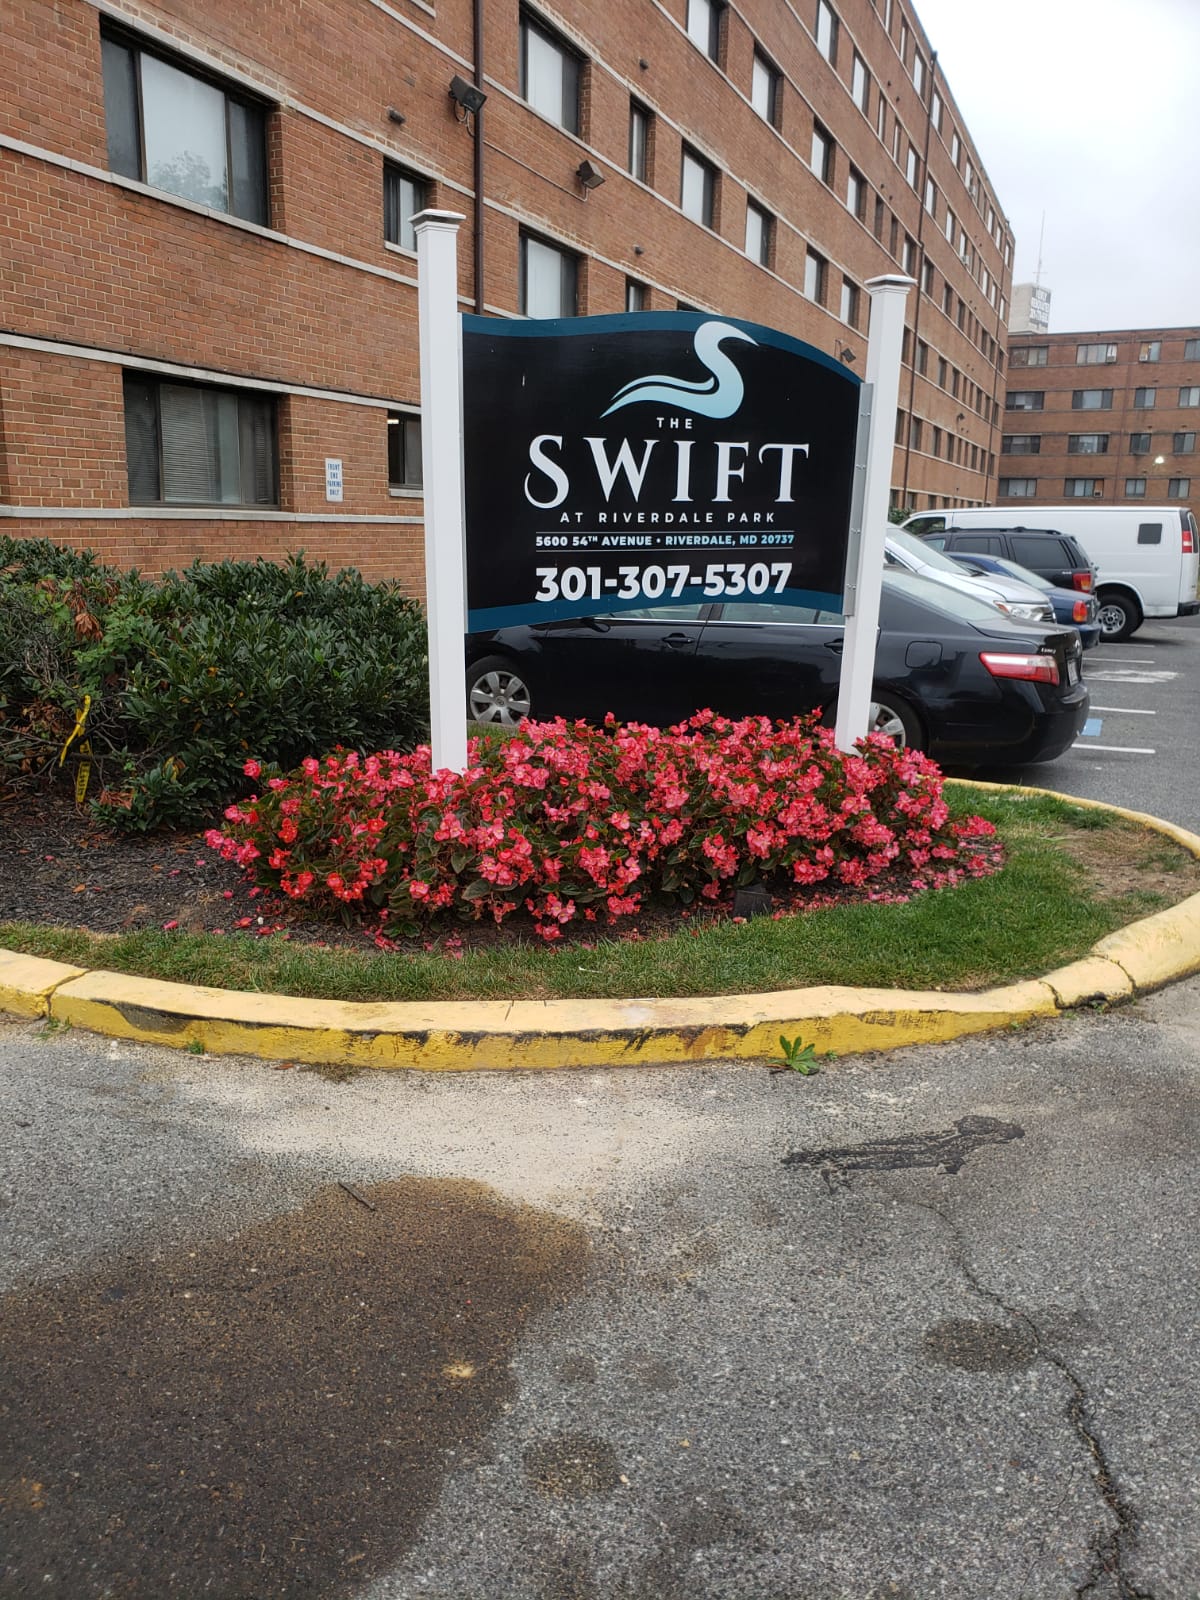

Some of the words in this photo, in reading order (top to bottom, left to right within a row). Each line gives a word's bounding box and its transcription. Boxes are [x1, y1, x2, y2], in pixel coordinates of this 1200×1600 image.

[656, 417, 693, 429] THE
[524, 434, 810, 509] SWIFT
[560, 512, 584, 523] AT
[598, 512, 713, 523] RIVERDALE
[727, 512, 775, 523] PARK
[535, 536, 568, 547] 5600
[572, 535, 598, 547] 54TH
[601, 535, 652, 546] AVENUE
[665, 535, 736, 546] RIVERDALE,
[739, 534, 758, 545] MD
[761, 534, 794, 544] 20737
[534, 562, 793, 602] 301-307-5307
